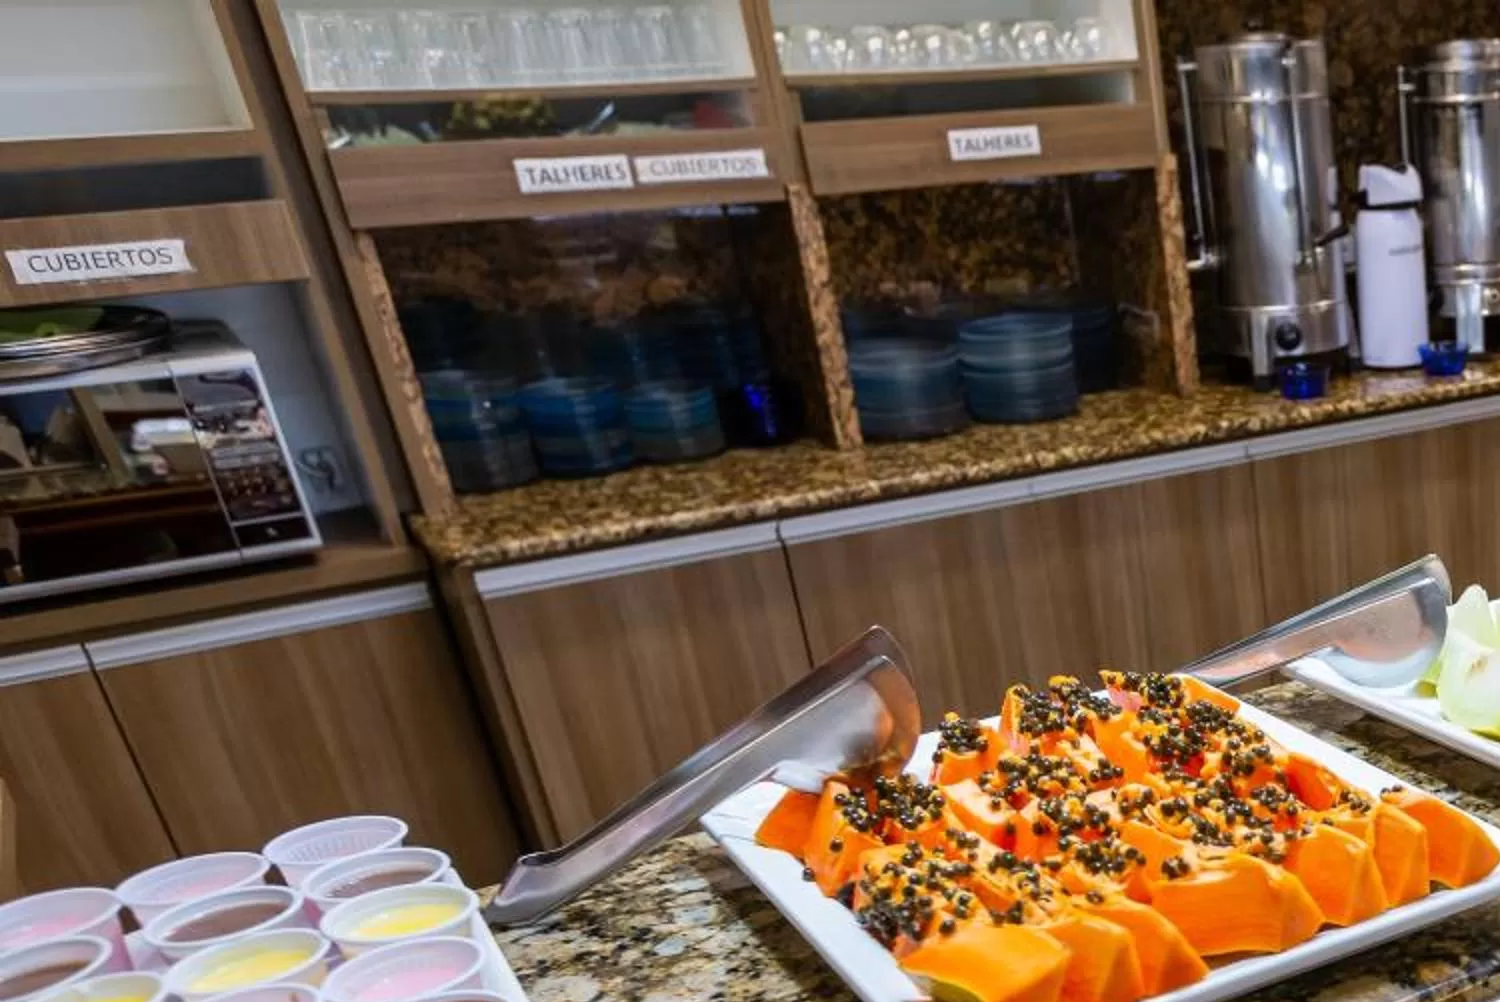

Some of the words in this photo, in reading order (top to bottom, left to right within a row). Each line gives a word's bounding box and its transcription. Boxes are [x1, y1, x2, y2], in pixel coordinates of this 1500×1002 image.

[524, 162, 627, 186] TALHERES
[649, 156, 759, 177] CUBIERTOS
[27, 246, 173, 274] CUBIERTOS
